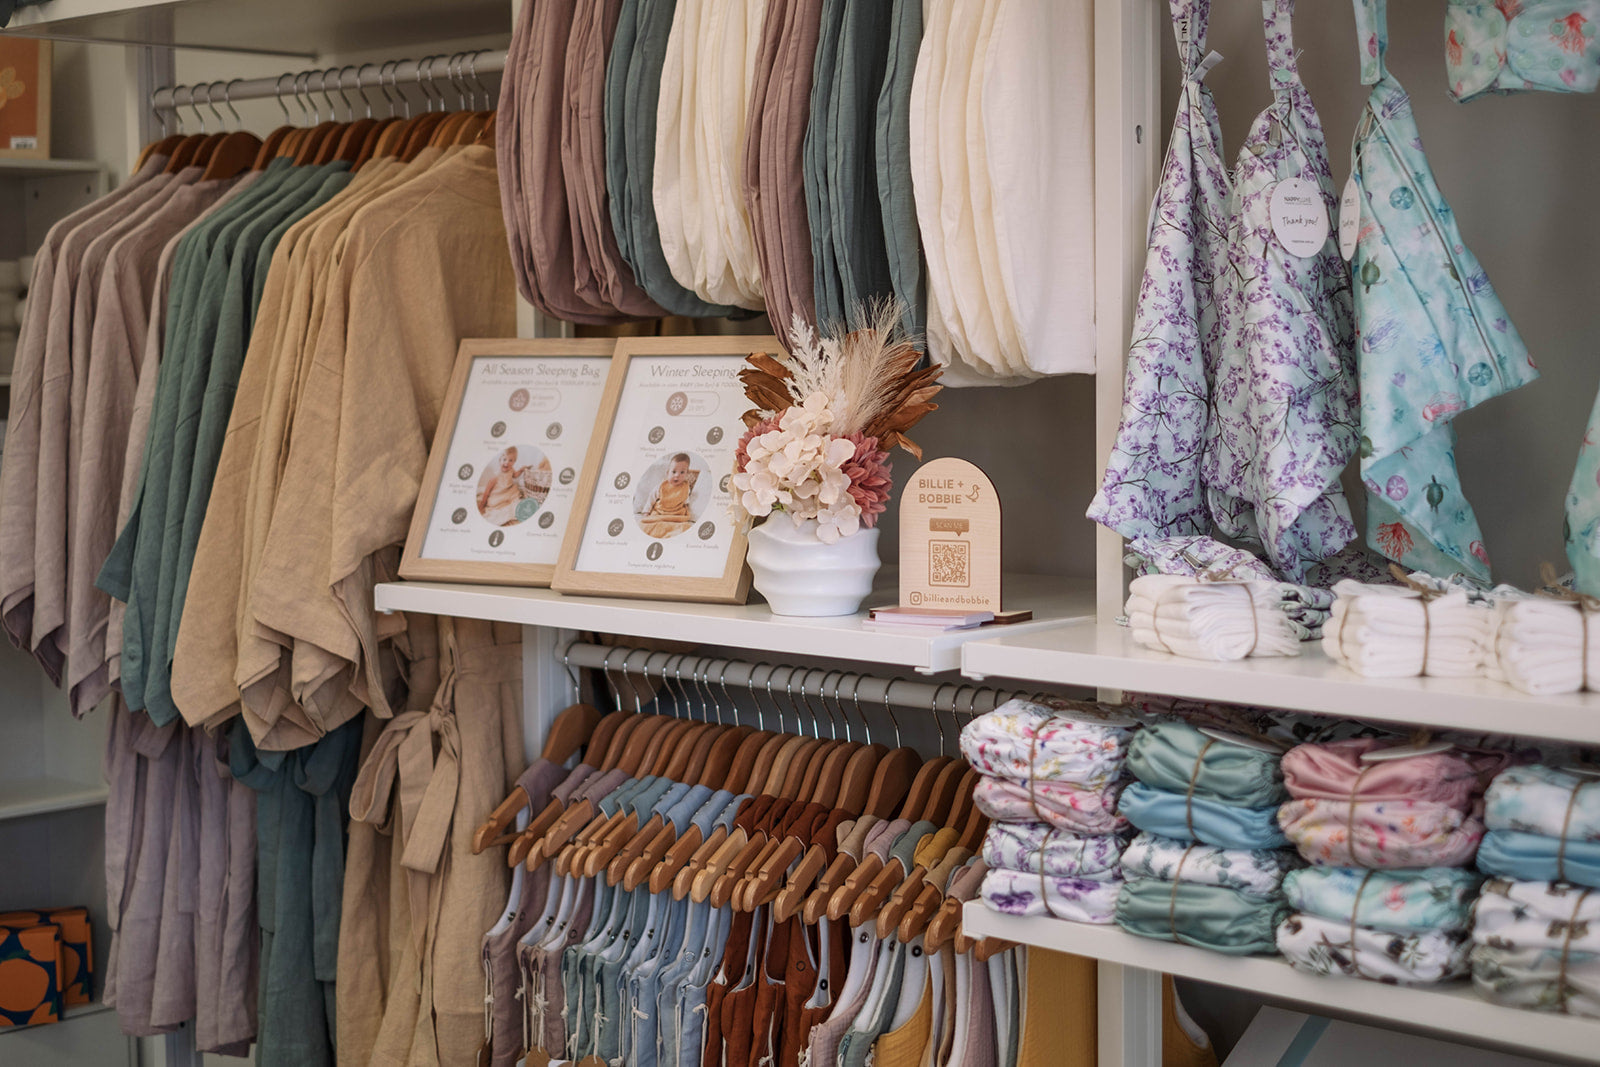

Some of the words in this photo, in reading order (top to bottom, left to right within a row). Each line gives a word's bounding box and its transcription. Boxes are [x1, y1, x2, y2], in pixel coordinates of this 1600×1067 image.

[1282, 214, 1303, 227] Thank
[1303, 216, 1319, 228] you!
[481, 363, 497, 376] All
[499, 363, 534, 377] Season
[536, 363, 579, 379] Sleeping
[580, 363, 601, 378] Bag
[651, 364, 689, 377] Winter
[691, 364, 737, 380] Sleeping
[919, 479, 954, 489] BILLIE
[919, 494, 962, 504] BOBBIE
[922, 592, 991, 606] billieandbobbie
